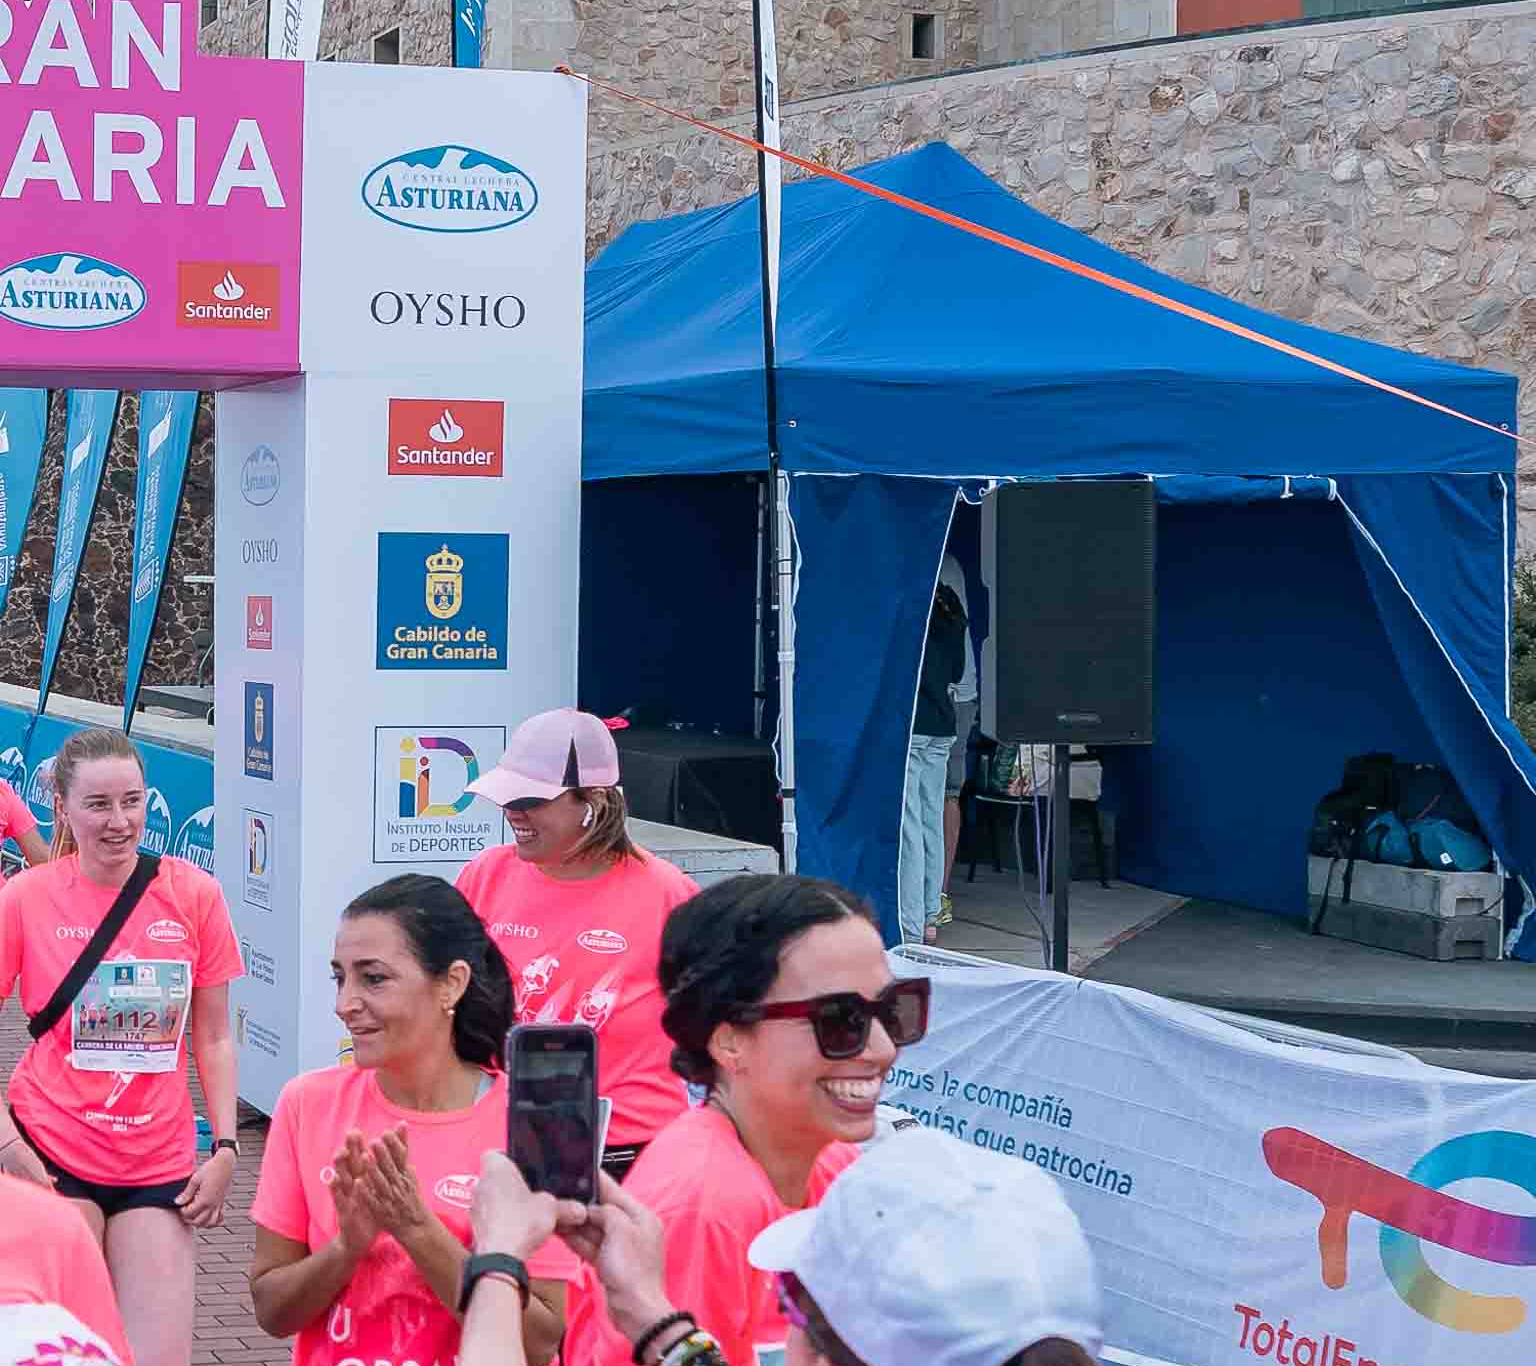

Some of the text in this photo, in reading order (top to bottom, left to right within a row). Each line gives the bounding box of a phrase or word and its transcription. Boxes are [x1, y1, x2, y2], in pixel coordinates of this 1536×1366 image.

[376, 174, 526, 213] ASTURIANA
[1, 280, 135, 314] ASTURIANA
[184, 301, 273, 322] Santander
[370, 290, 527, 329] OYSHO
[397, 445, 495, 466] Santander
[394, 626, 488, 643] Cabildo de
[386, 643, 498, 660] Gran Canaria
[386, 820, 491, 835] INSTITUTO INSULAR
[391, 837, 485, 853] DE DEPORTES
[112, 1011, 159, 1029] 112
[963, 1081, 1073, 1129] compañía
